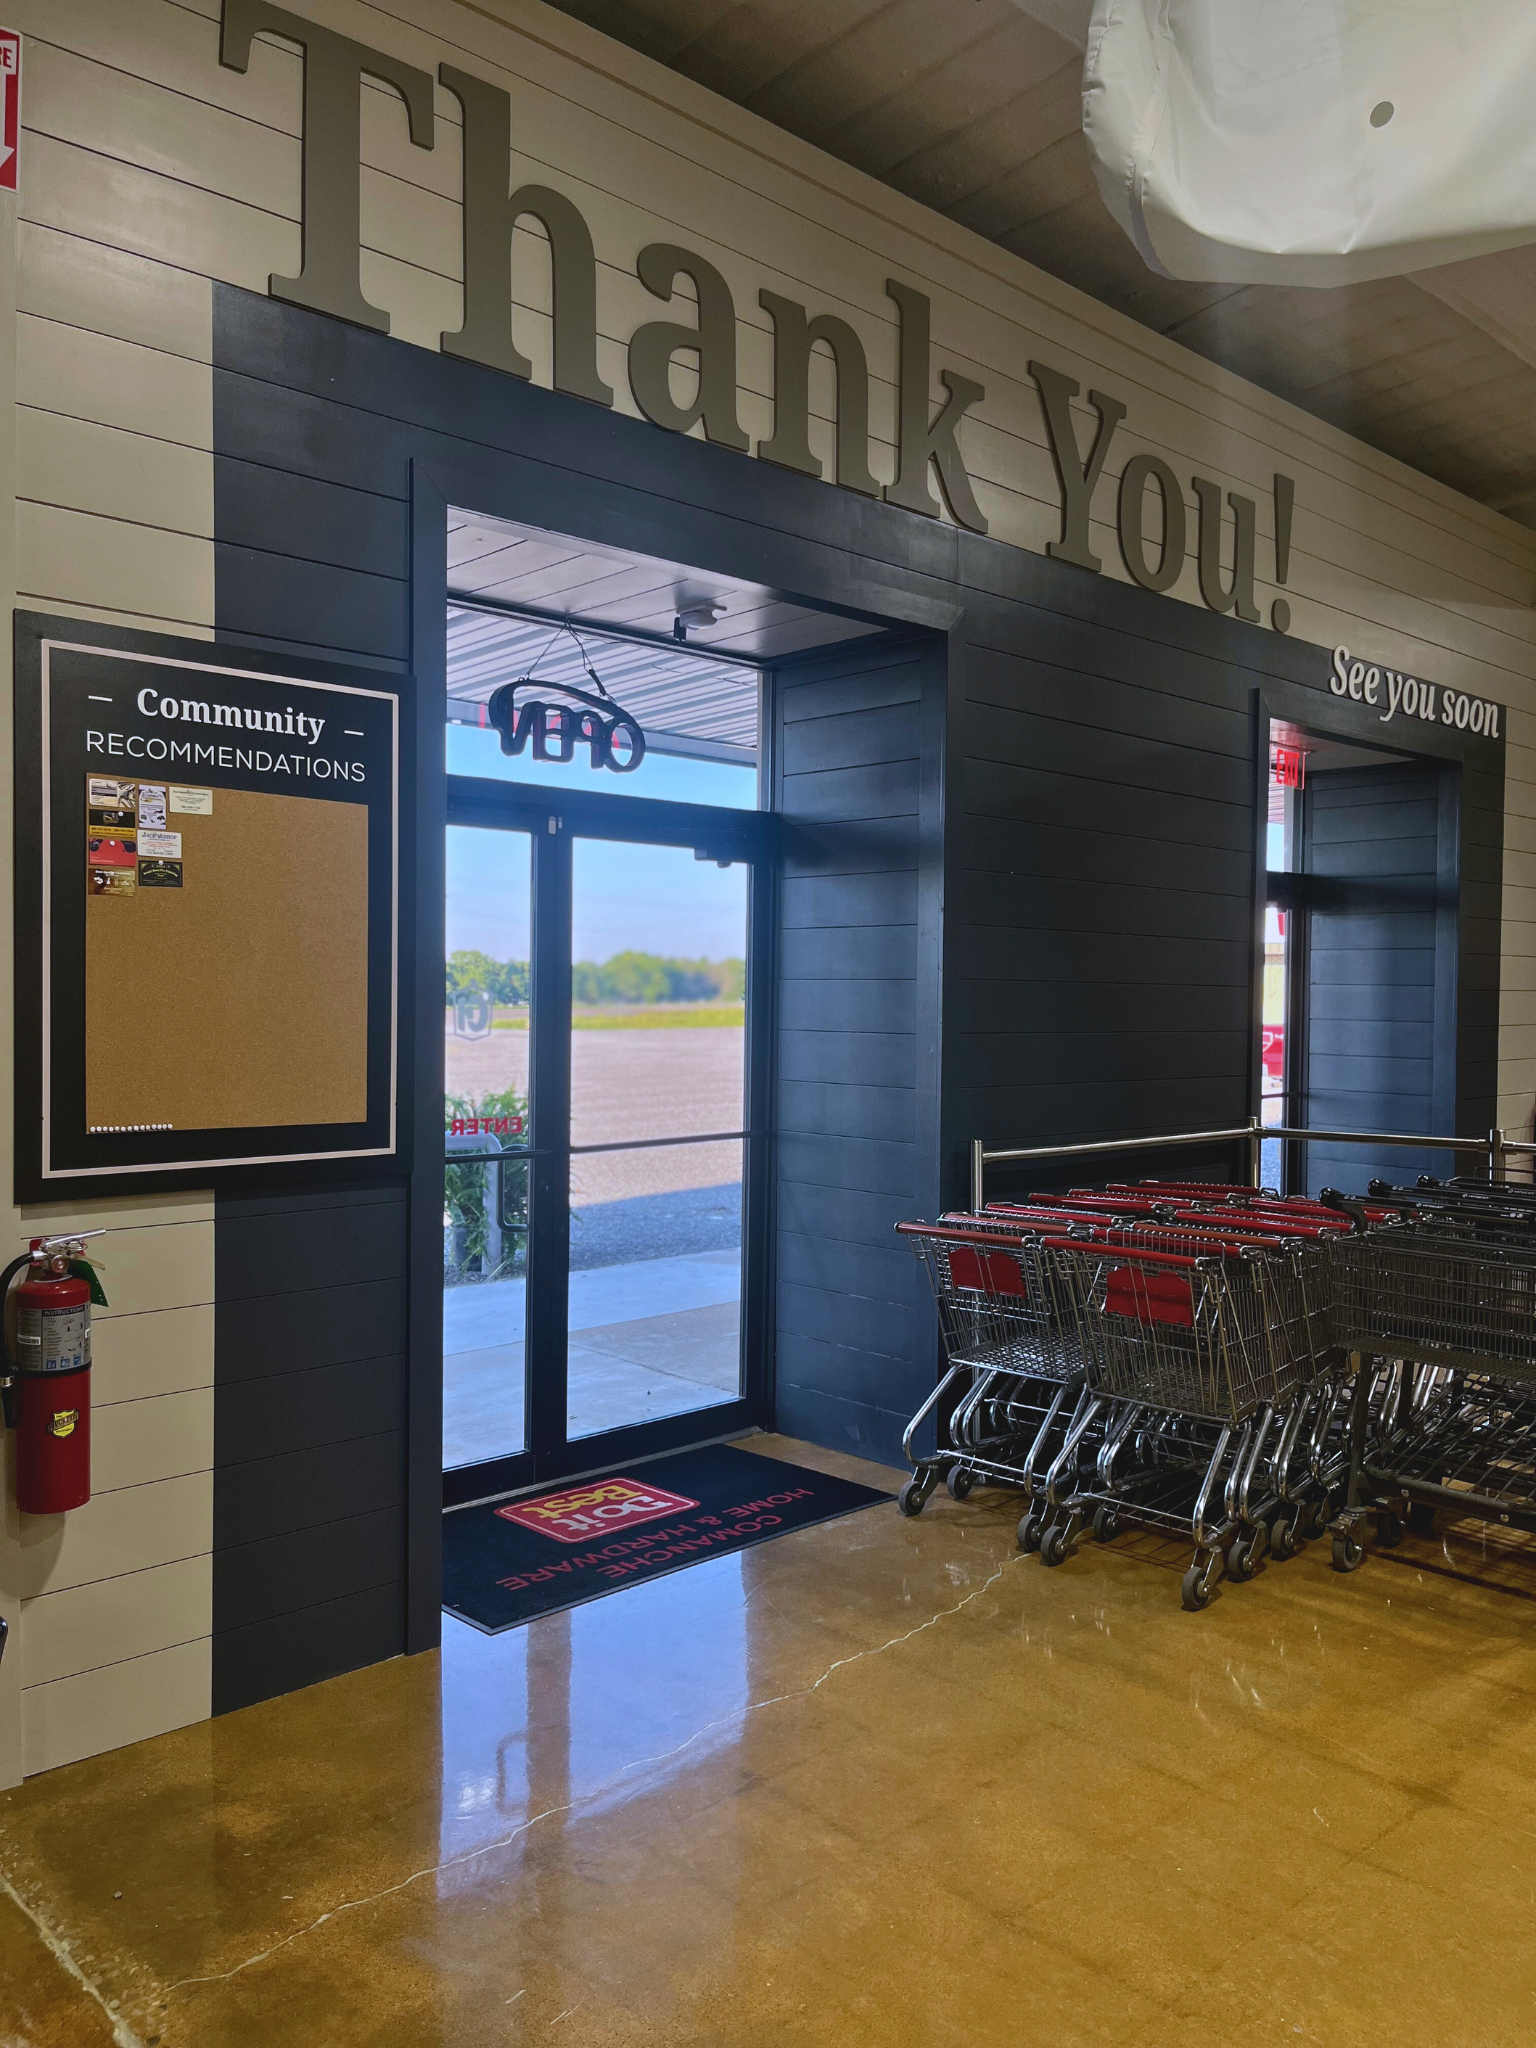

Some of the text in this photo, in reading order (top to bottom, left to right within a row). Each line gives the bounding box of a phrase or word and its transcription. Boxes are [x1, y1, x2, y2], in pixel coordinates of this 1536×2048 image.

[219, 0, 1295, 633] Thank You!
[136, 688, 326, 745] Community
[1330, 645, 1499, 739] See you soon
[86, 730, 366, 783] RECOMMENDATIONS
[1276, 748, 1301, 788] EXIT
[521, 1484, 643, 1520] Best
[495, 1487, 815, 1591] HOME & HARDWARE
[596, 1514, 783, 1579] COMANCHE
